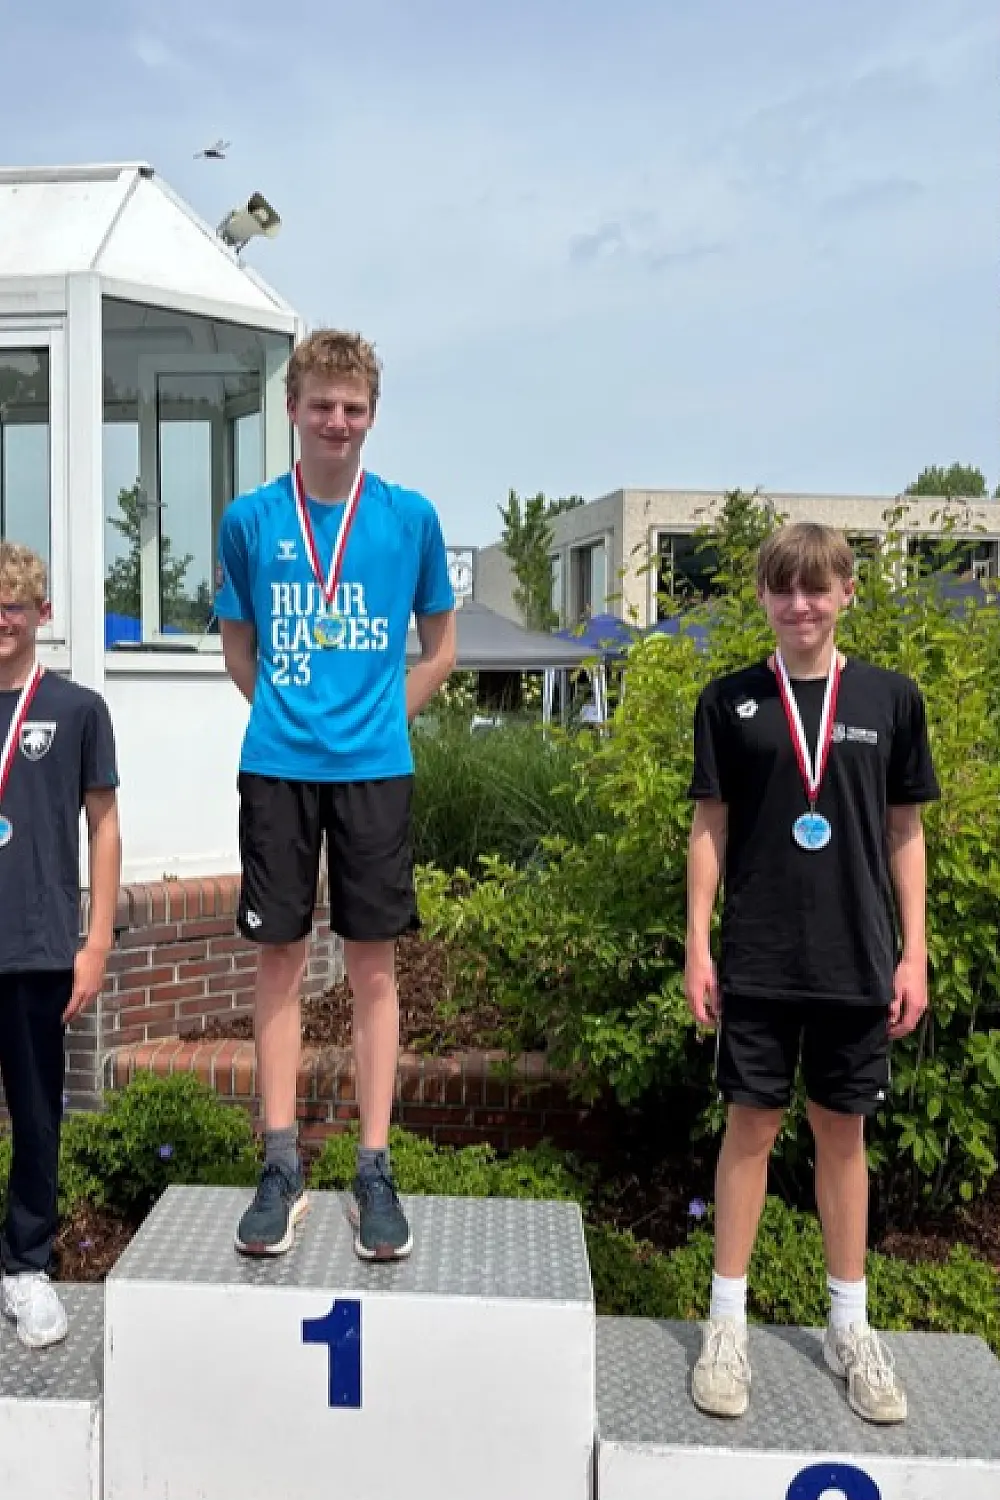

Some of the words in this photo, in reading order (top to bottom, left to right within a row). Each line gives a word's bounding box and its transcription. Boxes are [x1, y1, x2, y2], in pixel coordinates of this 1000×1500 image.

[271, 582, 367, 615] RUHR
[271, 617, 388, 650] GAES
[271, 653, 311, 686] 23
[302, 1299, 362, 1409] 1
